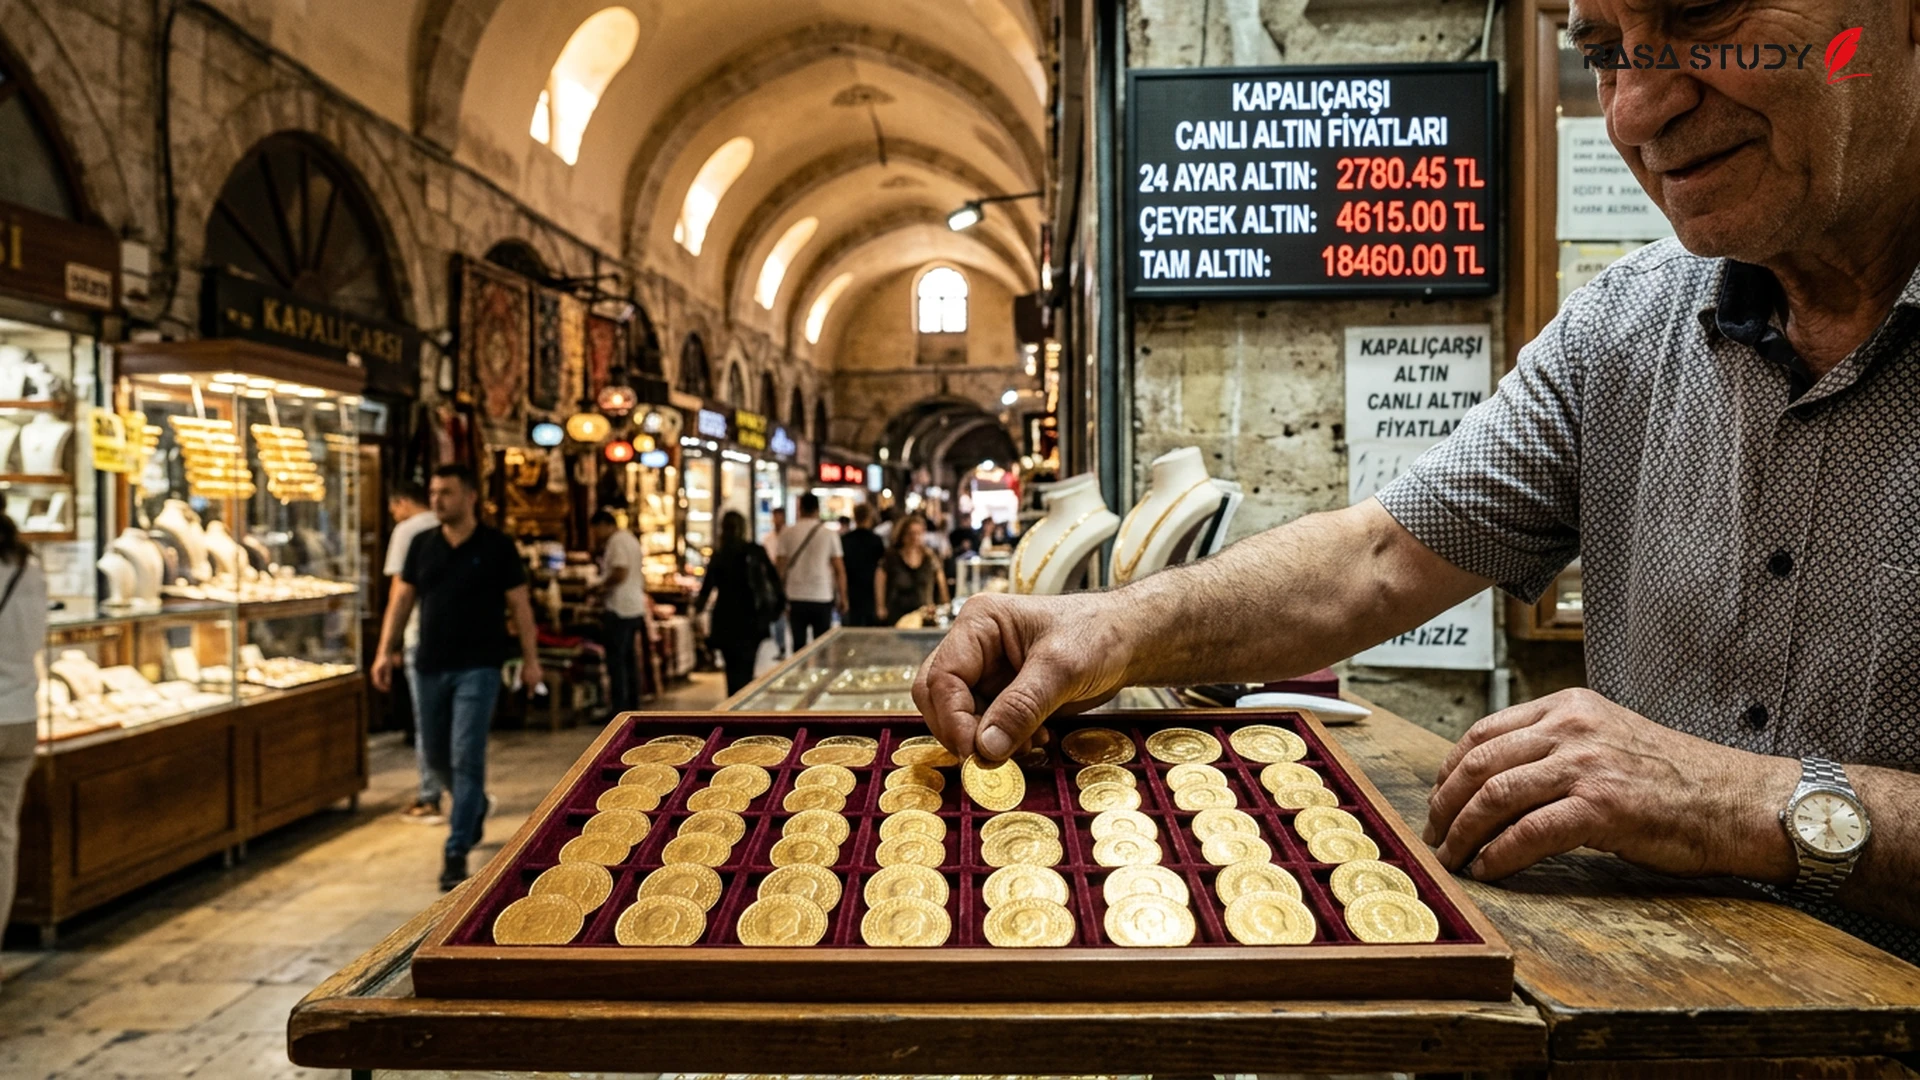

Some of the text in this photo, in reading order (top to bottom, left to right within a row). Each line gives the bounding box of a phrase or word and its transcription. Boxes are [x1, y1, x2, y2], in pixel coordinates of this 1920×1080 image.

[1232, 79, 1391, 115] KAPALIÇARŞI
[1175, 112, 1448, 151] CANLI ALTIN FİYATLARI
[1139, 157, 1485, 193] 24 AYAR ALTIN: 2780.45 TL
[1139, 200, 1485, 242] ÇEYREK ALTIN: 4615.00 TL
[1139, 244, 1485, 280] TAM ALTIN: 18460.00 TL
[1360, 336, 1483, 359] KAPALIÇARŞI
[1394, 365, 1449, 382] ALTIN
[1367, 391, 1482, 410] CANLI ALTIN
